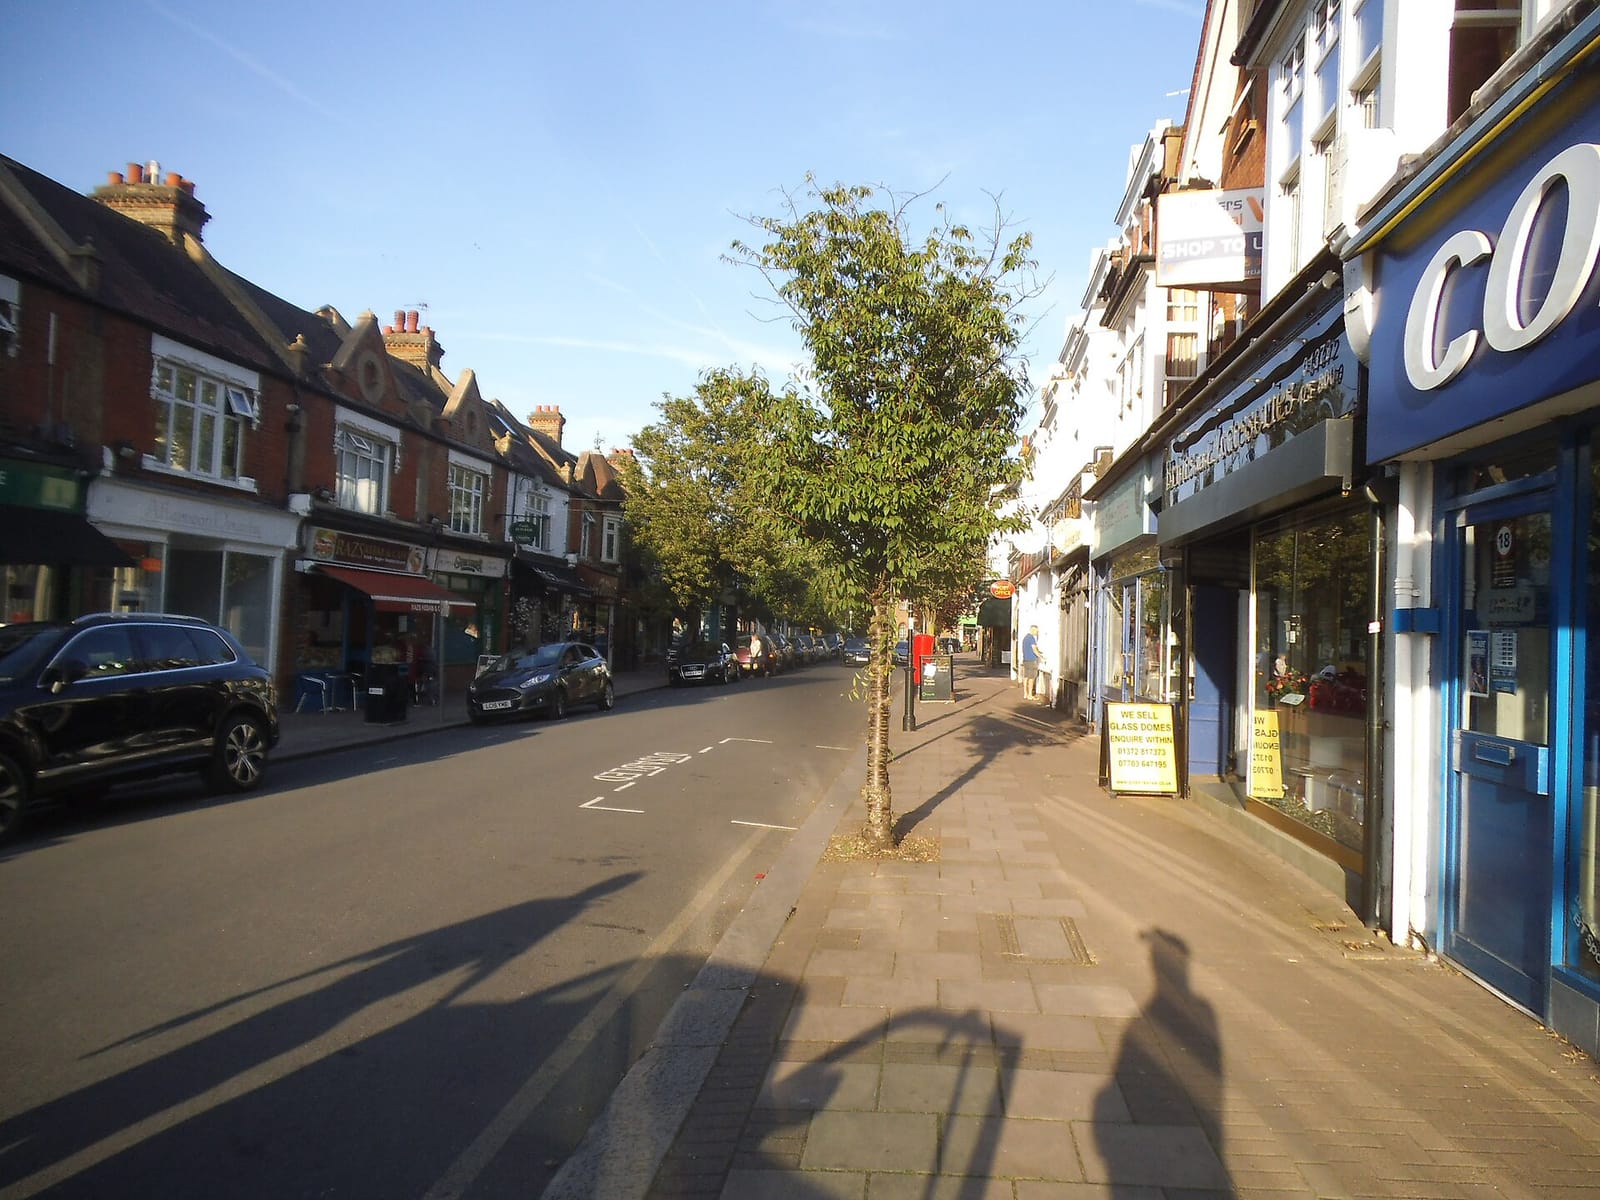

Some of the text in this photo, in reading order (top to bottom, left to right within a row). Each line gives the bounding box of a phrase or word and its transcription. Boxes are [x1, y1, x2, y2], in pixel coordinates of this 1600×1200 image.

[1162, 240, 1215, 259] SHOP
[1221, 238, 1245, 254] TO
[1404, 143, 1600, 391] CO
[1498, 532, 1511, 548] 18
[1120, 711, 1158, 720] WE SELL
[1110, 723, 1172, 732] GLASS DOMES
[1110, 735, 1173, 744] ENQUIRE WITHIN
[1117, 748, 1138, 756] 01372
